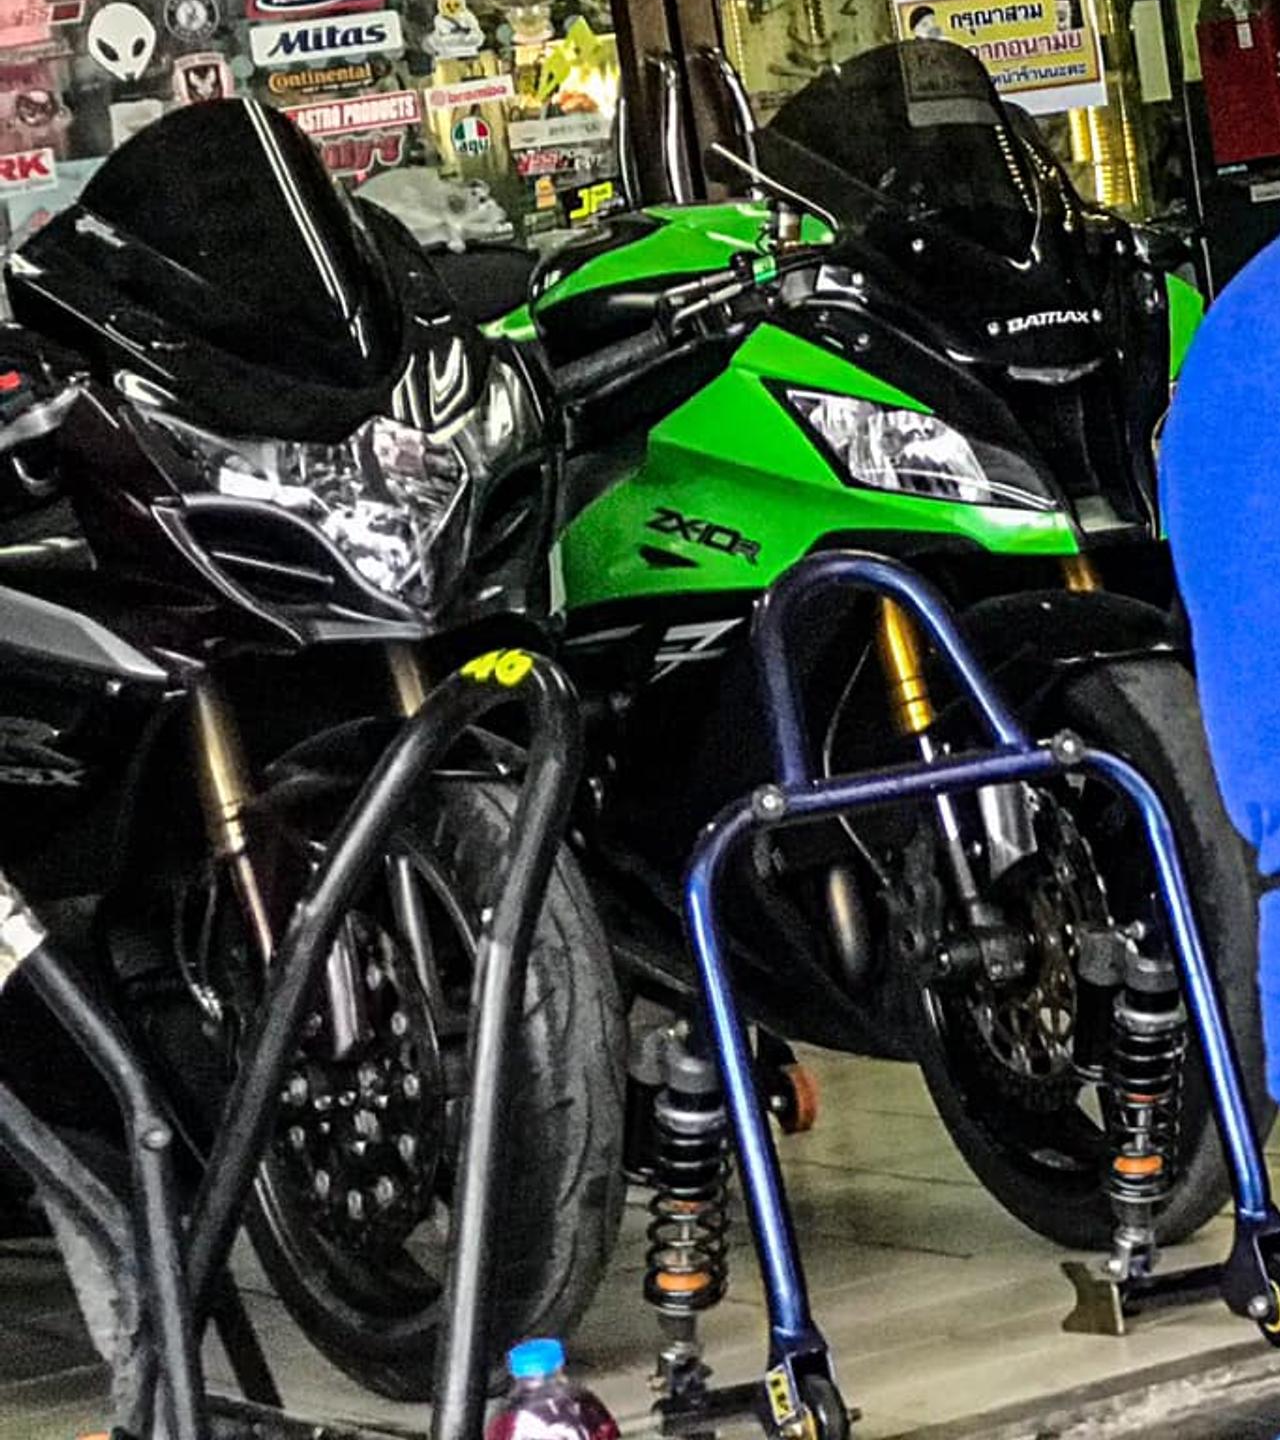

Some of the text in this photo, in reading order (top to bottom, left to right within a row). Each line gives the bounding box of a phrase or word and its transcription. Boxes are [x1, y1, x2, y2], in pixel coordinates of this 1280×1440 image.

[950, 3, 1043, 37] กรุณาสวม
[268, 24, 387, 58] Mitas
[268, 62, 372, 93] Continental
[343, 95, 415, 125] PRODUCTS
